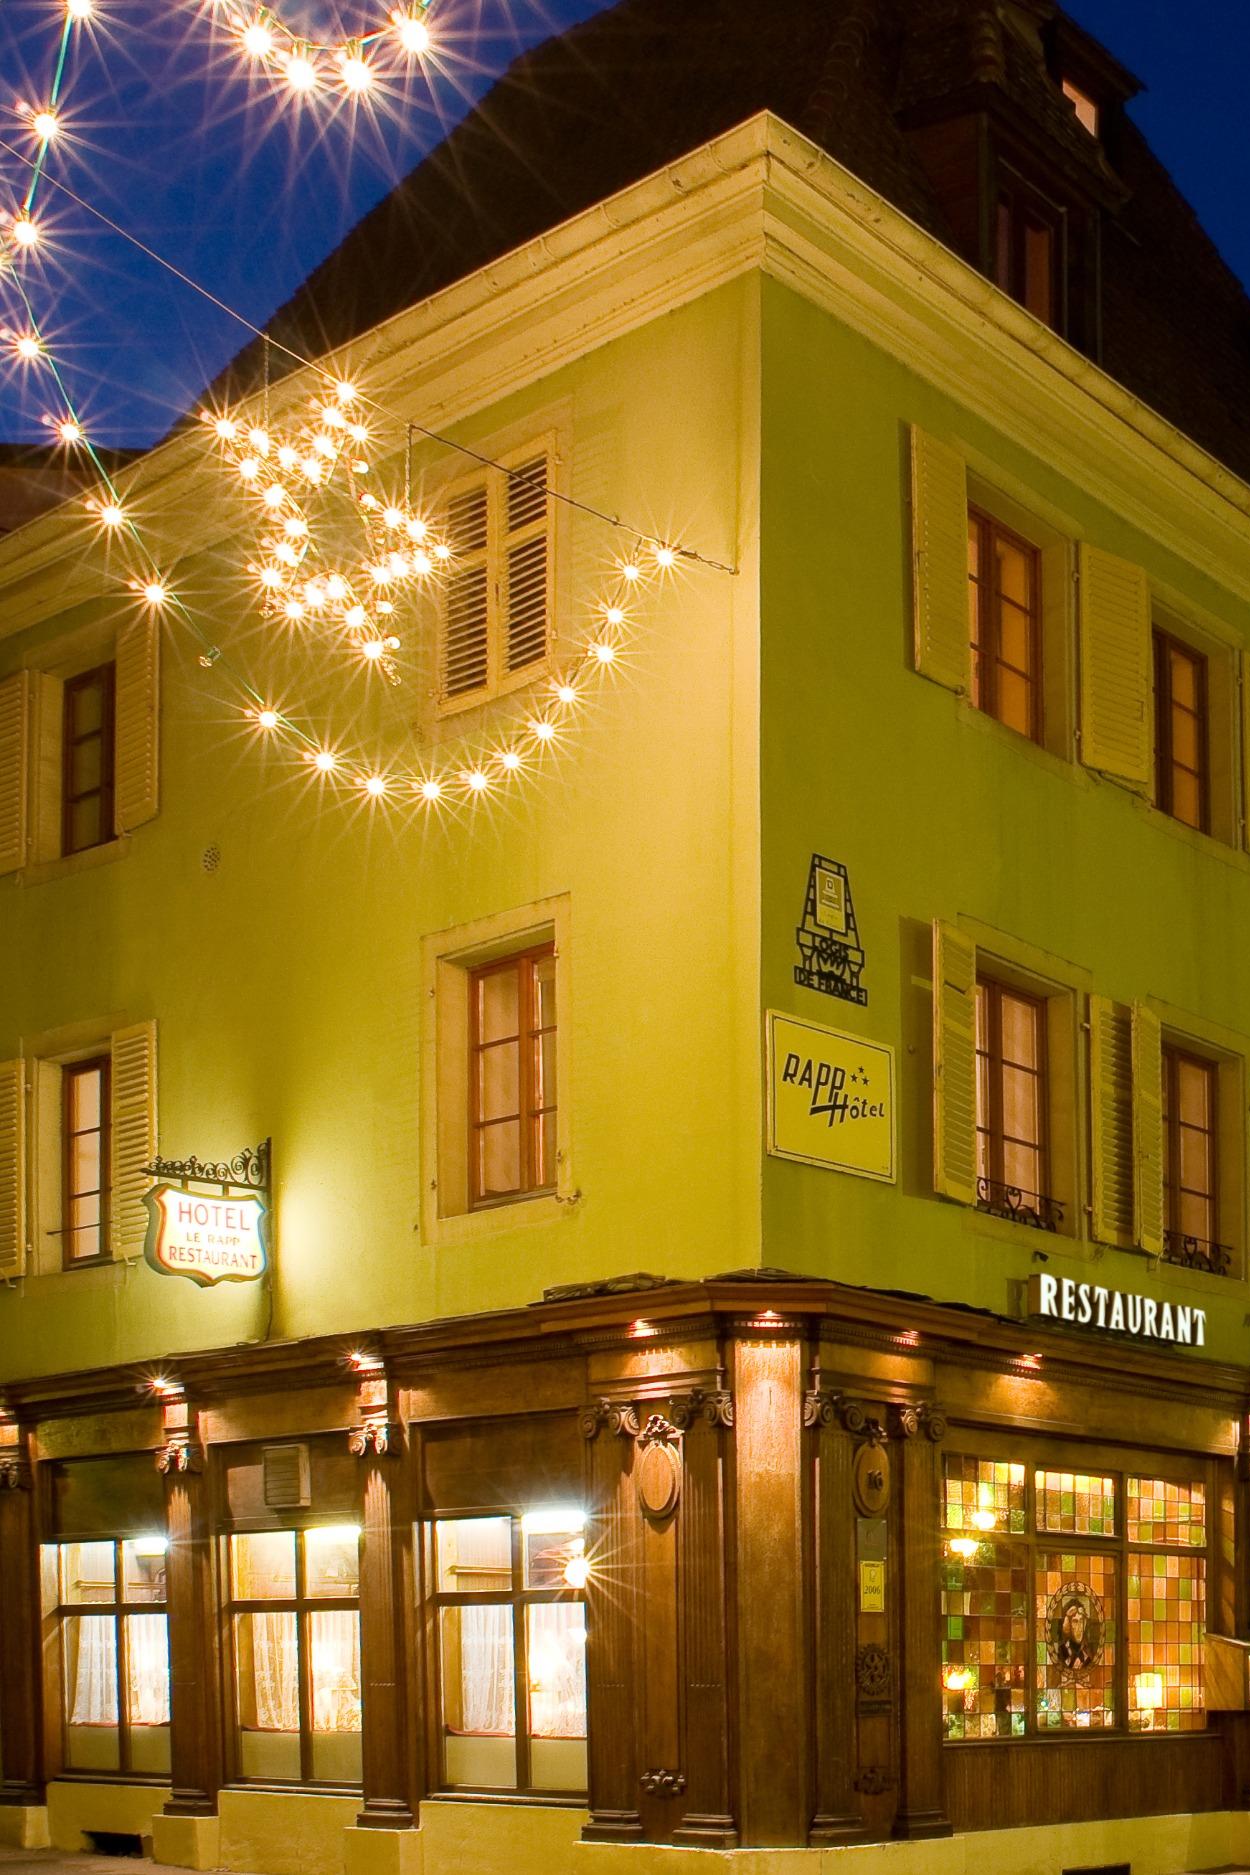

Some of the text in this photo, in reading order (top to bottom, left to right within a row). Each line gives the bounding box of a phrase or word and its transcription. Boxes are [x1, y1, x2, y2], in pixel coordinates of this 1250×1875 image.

[818, 974, 866, 1004] FRANCE
[782, 1053, 846, 1106] RAPP
[809, 1091, 885, 1128] Hôtel
[178, 1201, 251, 1231] HOTEL
[186, 1232, 201, 1243] LE
[169, 1246, 258, 1269] RESTAURANT
[1040, 1273, 1207, 1346] RESTAURANT
